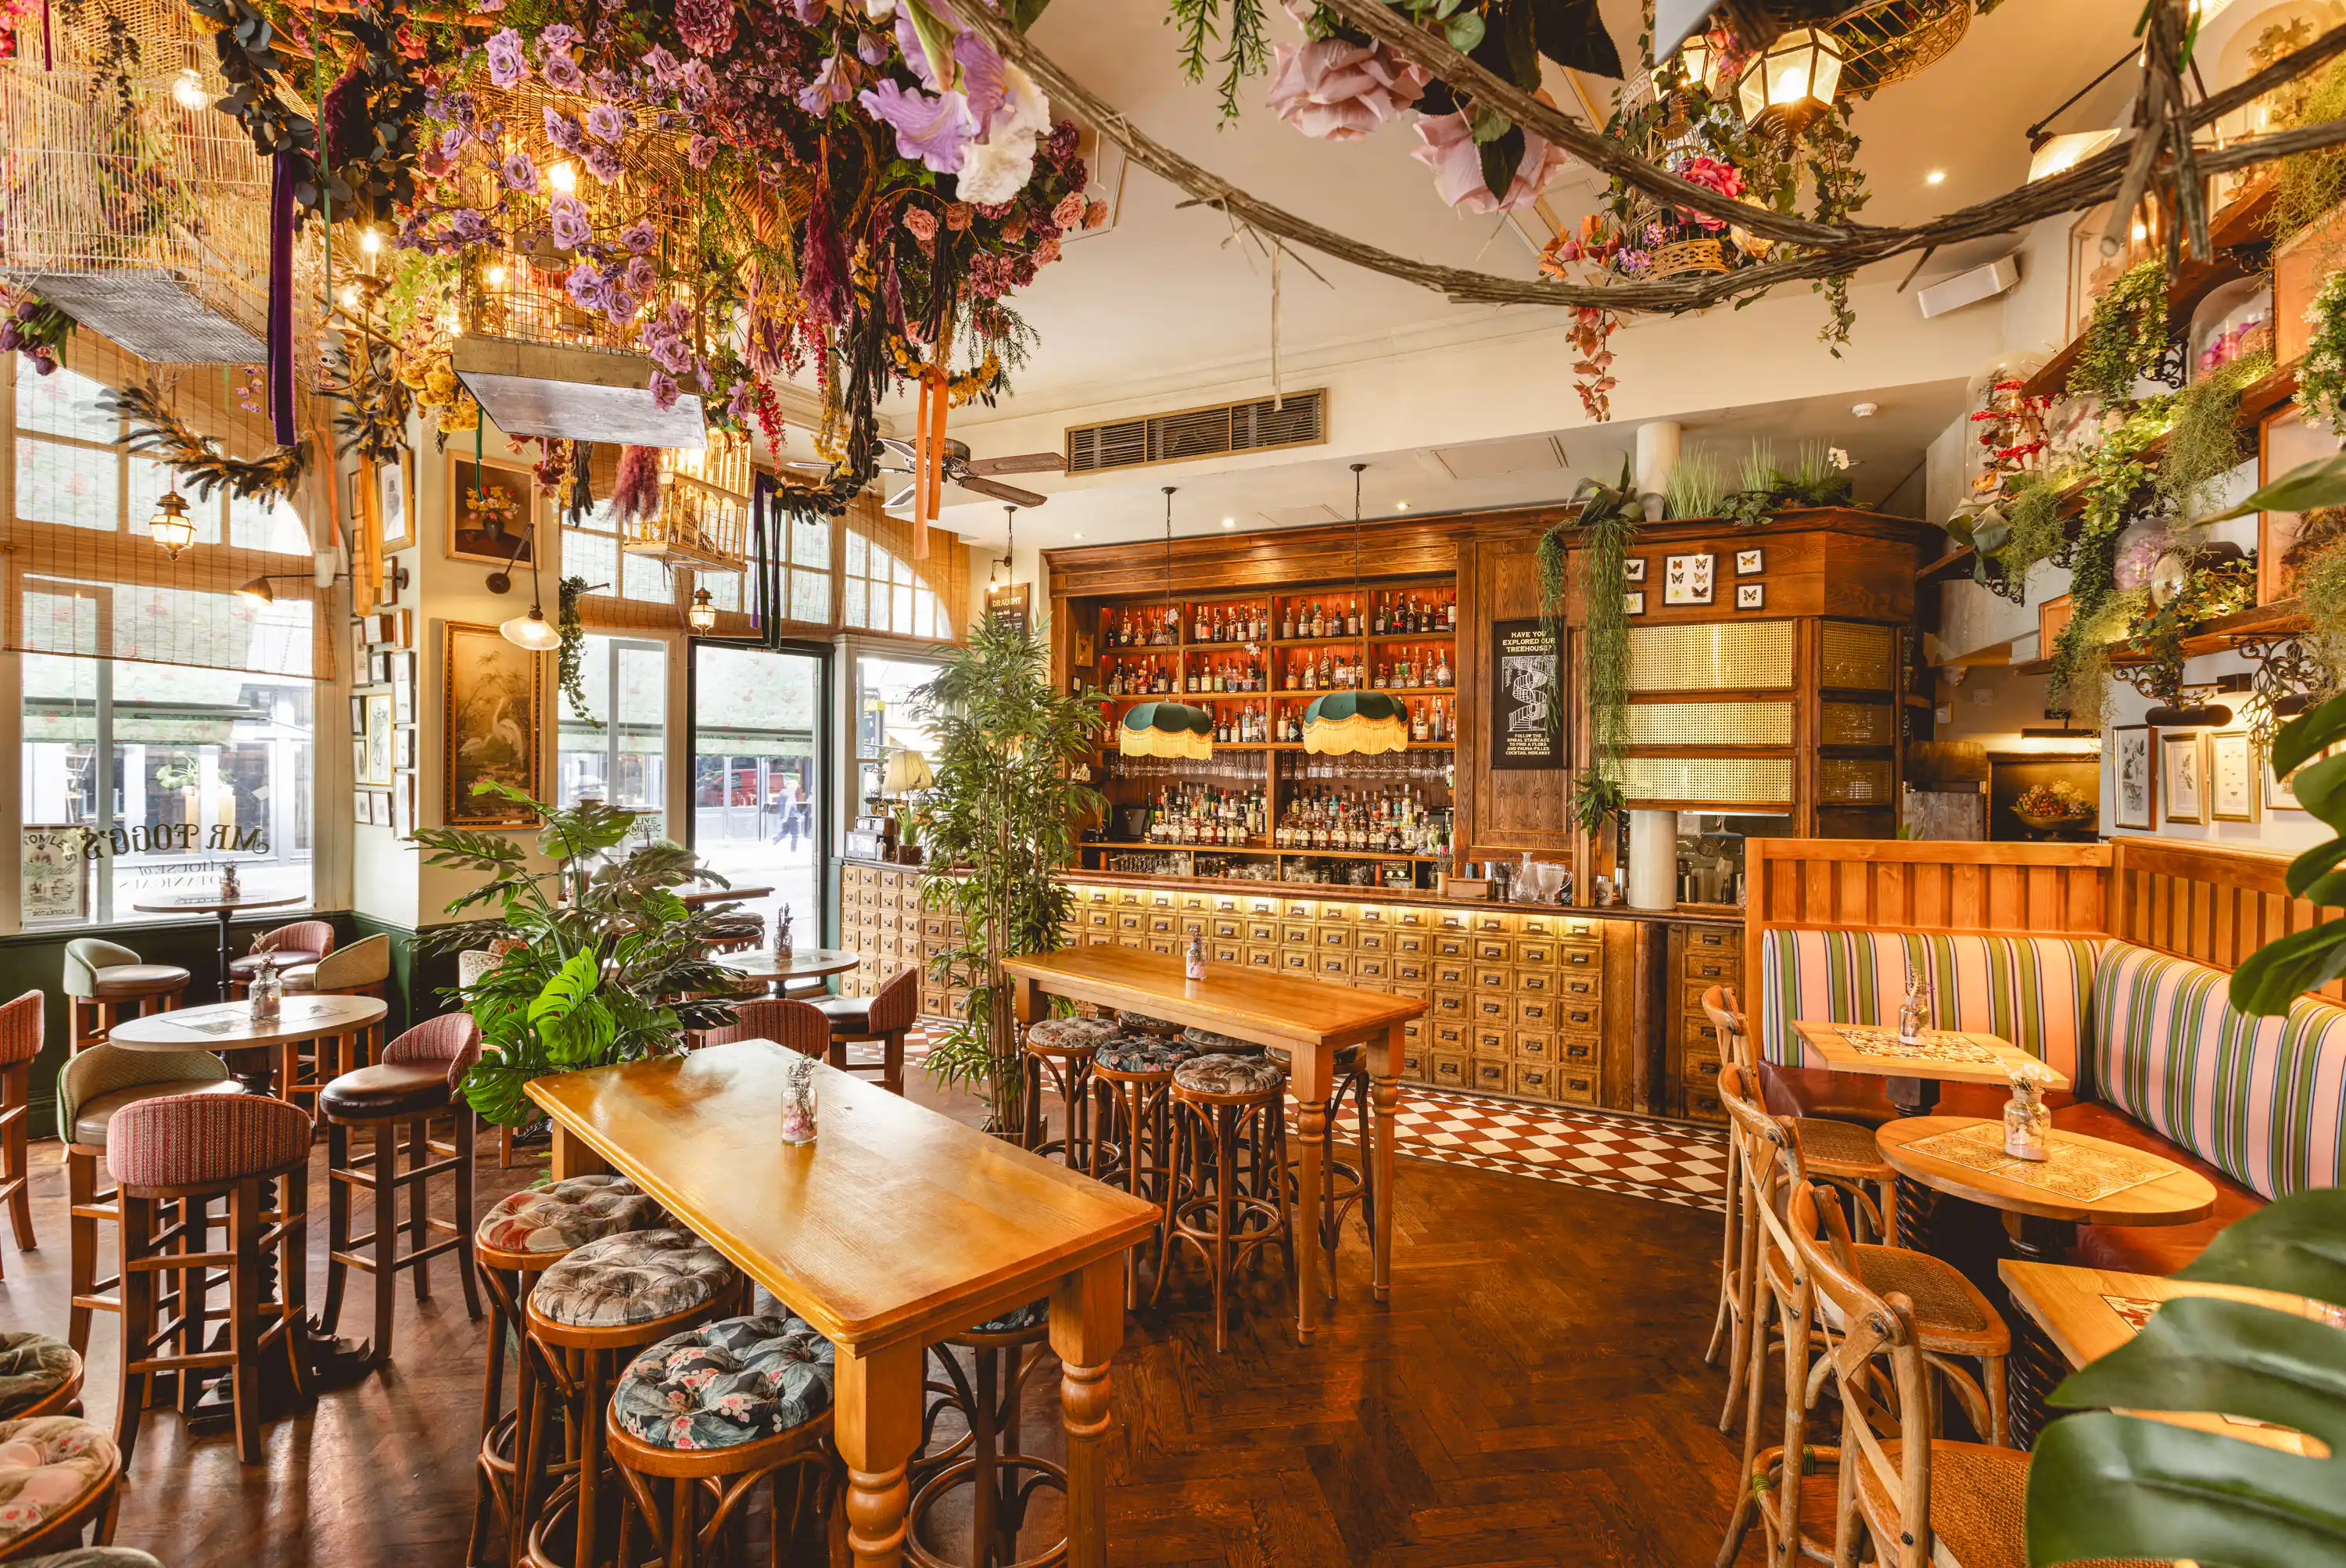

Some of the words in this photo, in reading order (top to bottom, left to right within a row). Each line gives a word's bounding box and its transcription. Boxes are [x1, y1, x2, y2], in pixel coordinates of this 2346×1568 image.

[992, 597, 1021, 608] DRAUGHT
[1506, 644, 1552, 653] TREEHOUSE?
[636, 816, 657, 825] LIVE
[631, 824, 662, 833] MUSIC
[32, 908, 76, 917] BOTANICALS
